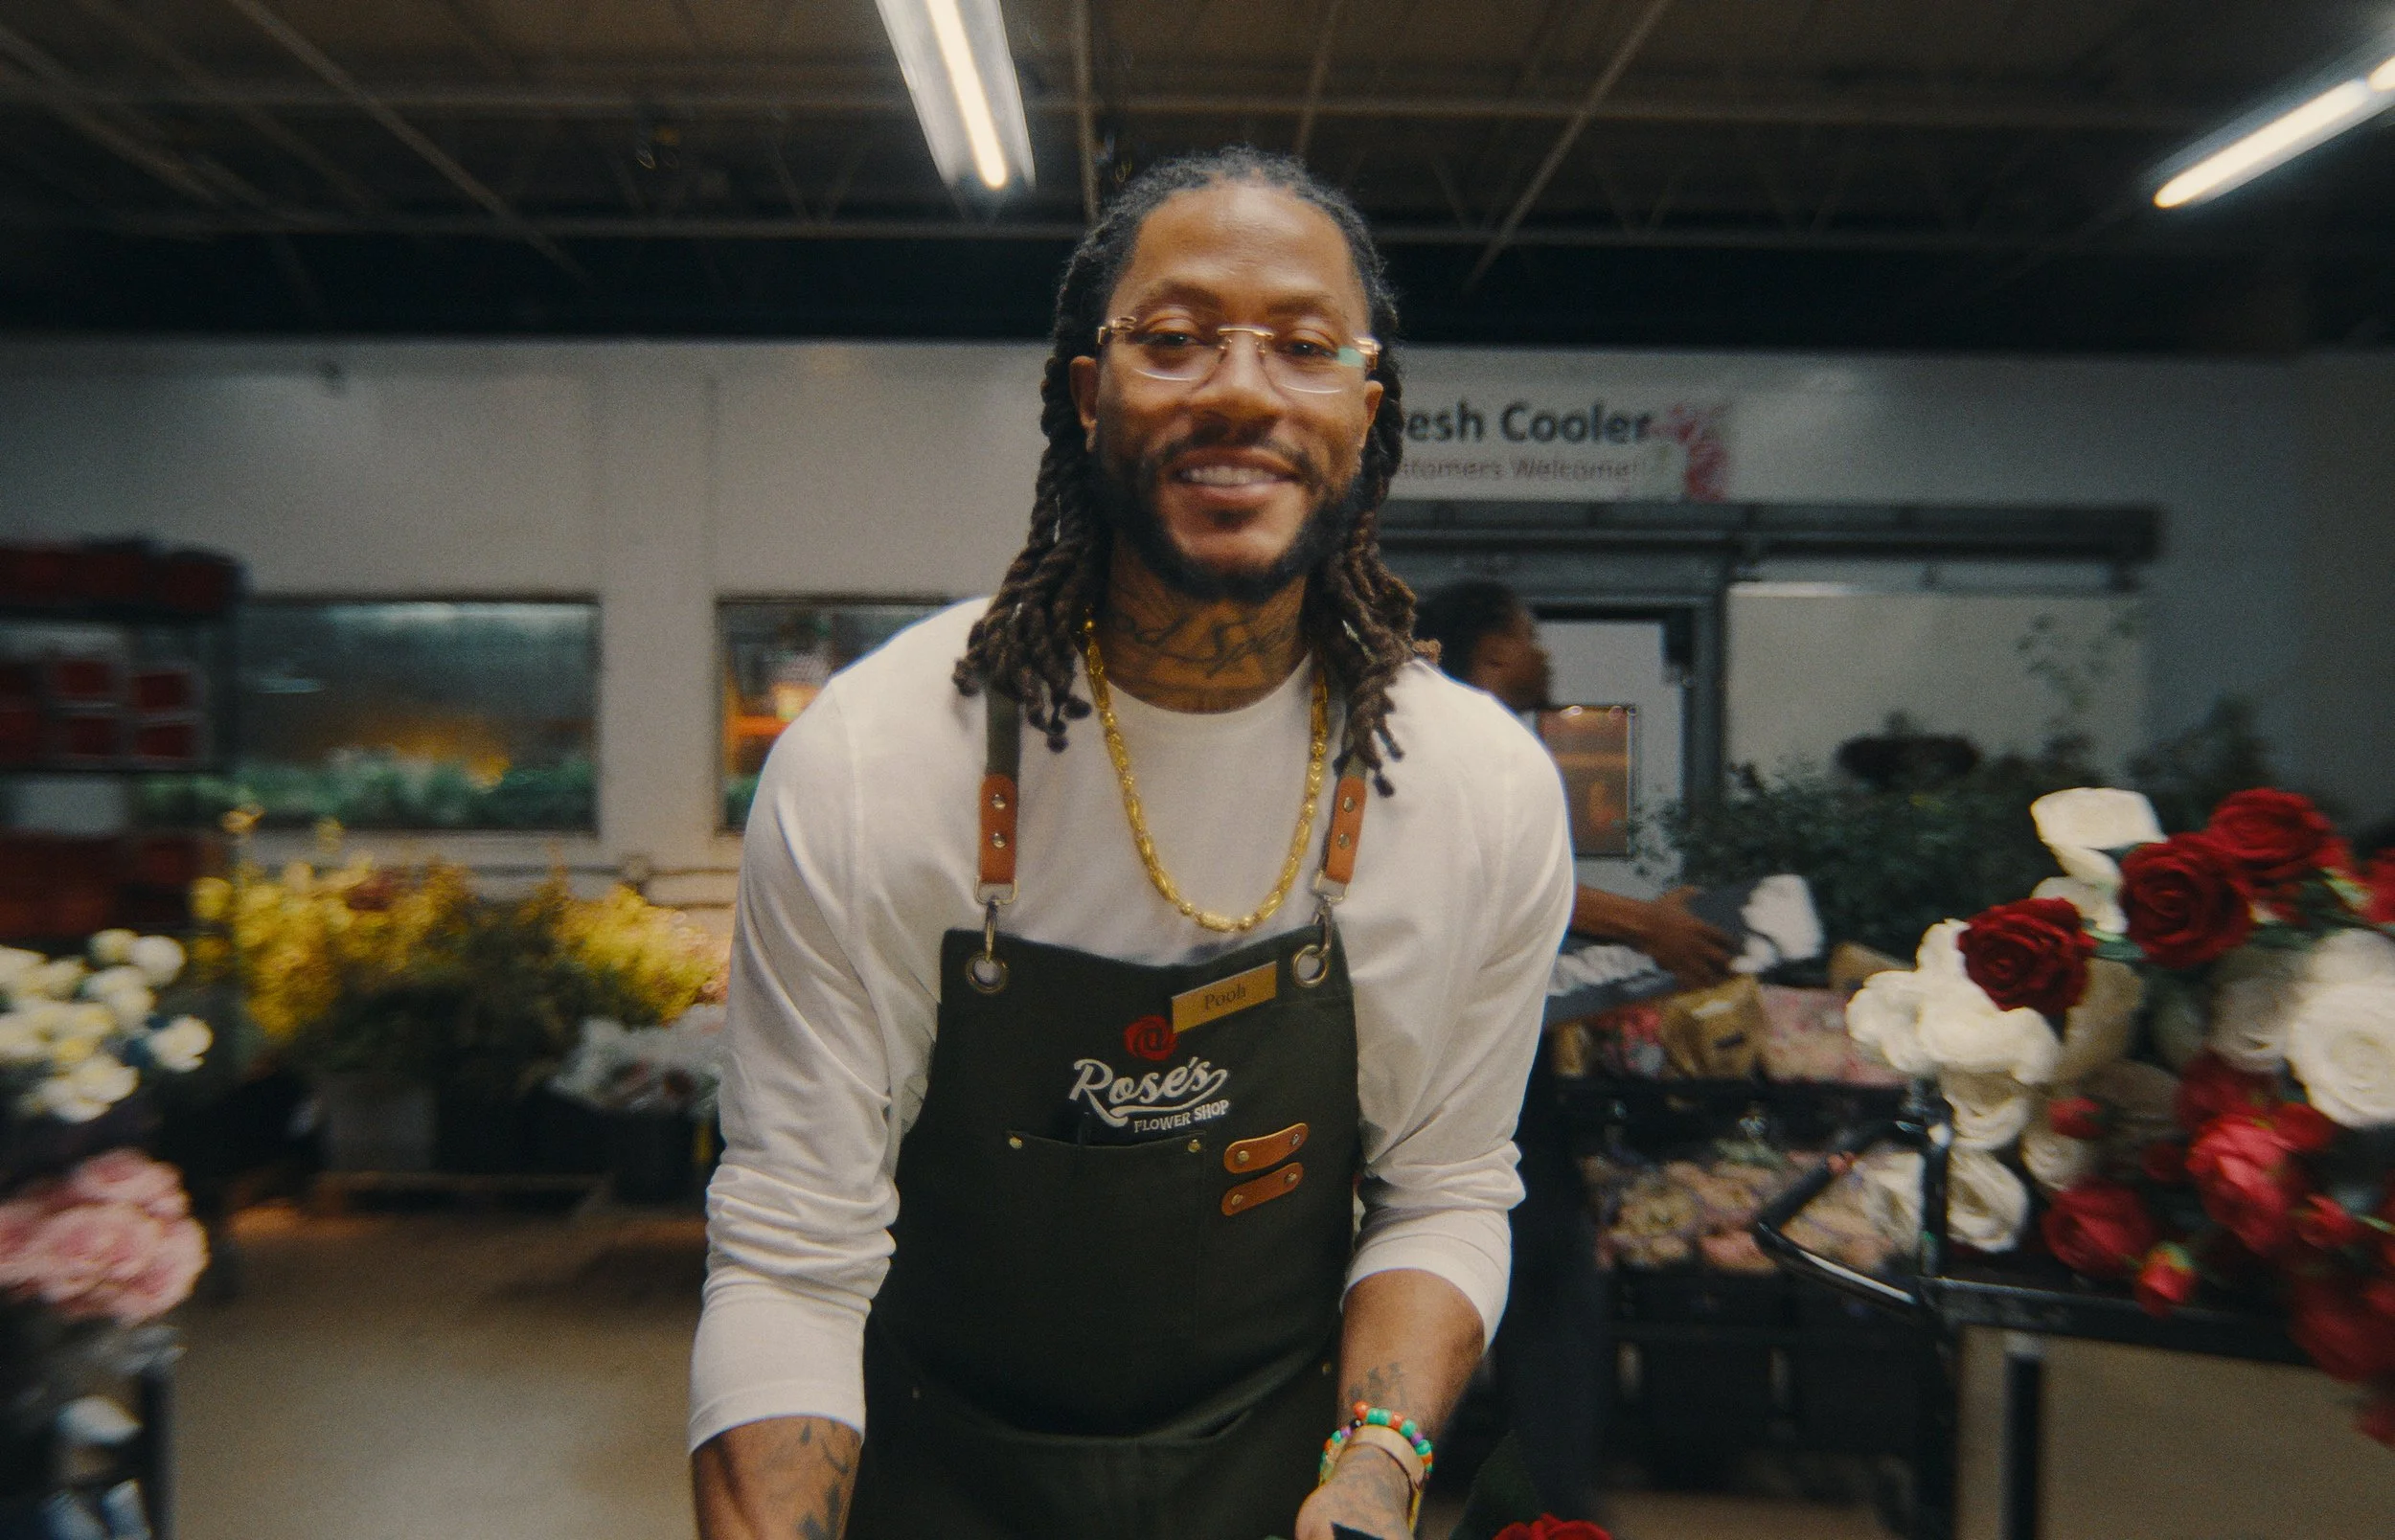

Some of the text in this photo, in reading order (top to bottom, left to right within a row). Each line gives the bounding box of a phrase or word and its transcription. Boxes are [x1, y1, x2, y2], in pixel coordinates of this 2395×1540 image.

[1405, 399, 1654, 443] esh Cooler
[1203, 984, 1247, 1011] Pooh
[1068, 1056, 1228, 1127] Rose's
[1133, 1098, 1230, 1134] FLOWER SHOP
